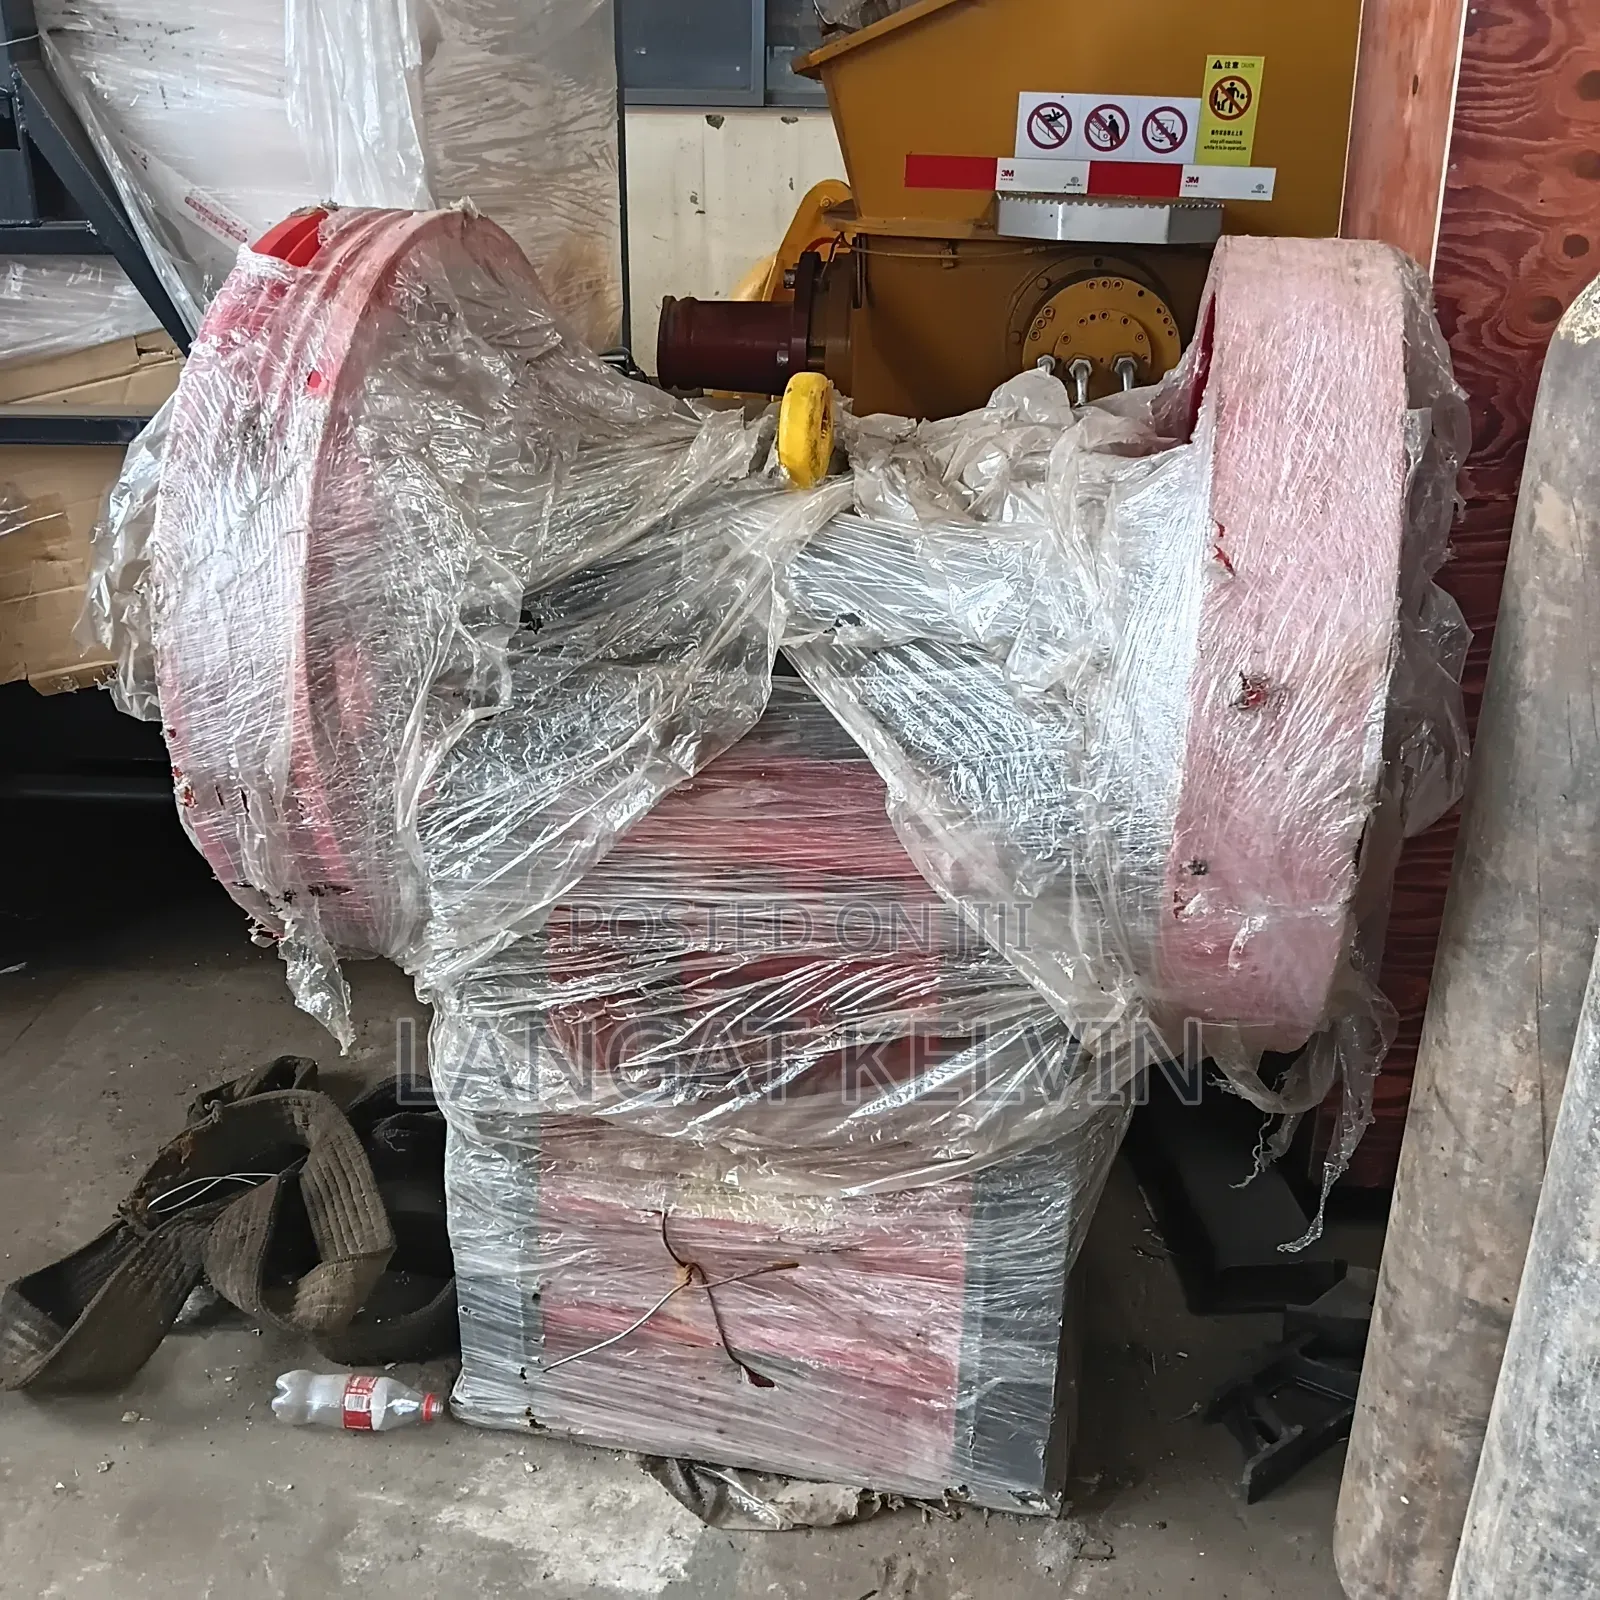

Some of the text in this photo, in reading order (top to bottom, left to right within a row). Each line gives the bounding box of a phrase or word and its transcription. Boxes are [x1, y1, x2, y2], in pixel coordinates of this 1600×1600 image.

[1224, 61, 1239, 69] 注意
[1001, 169, 1014, 177] 3M
[1186, 176, 1199, 184] 3M
